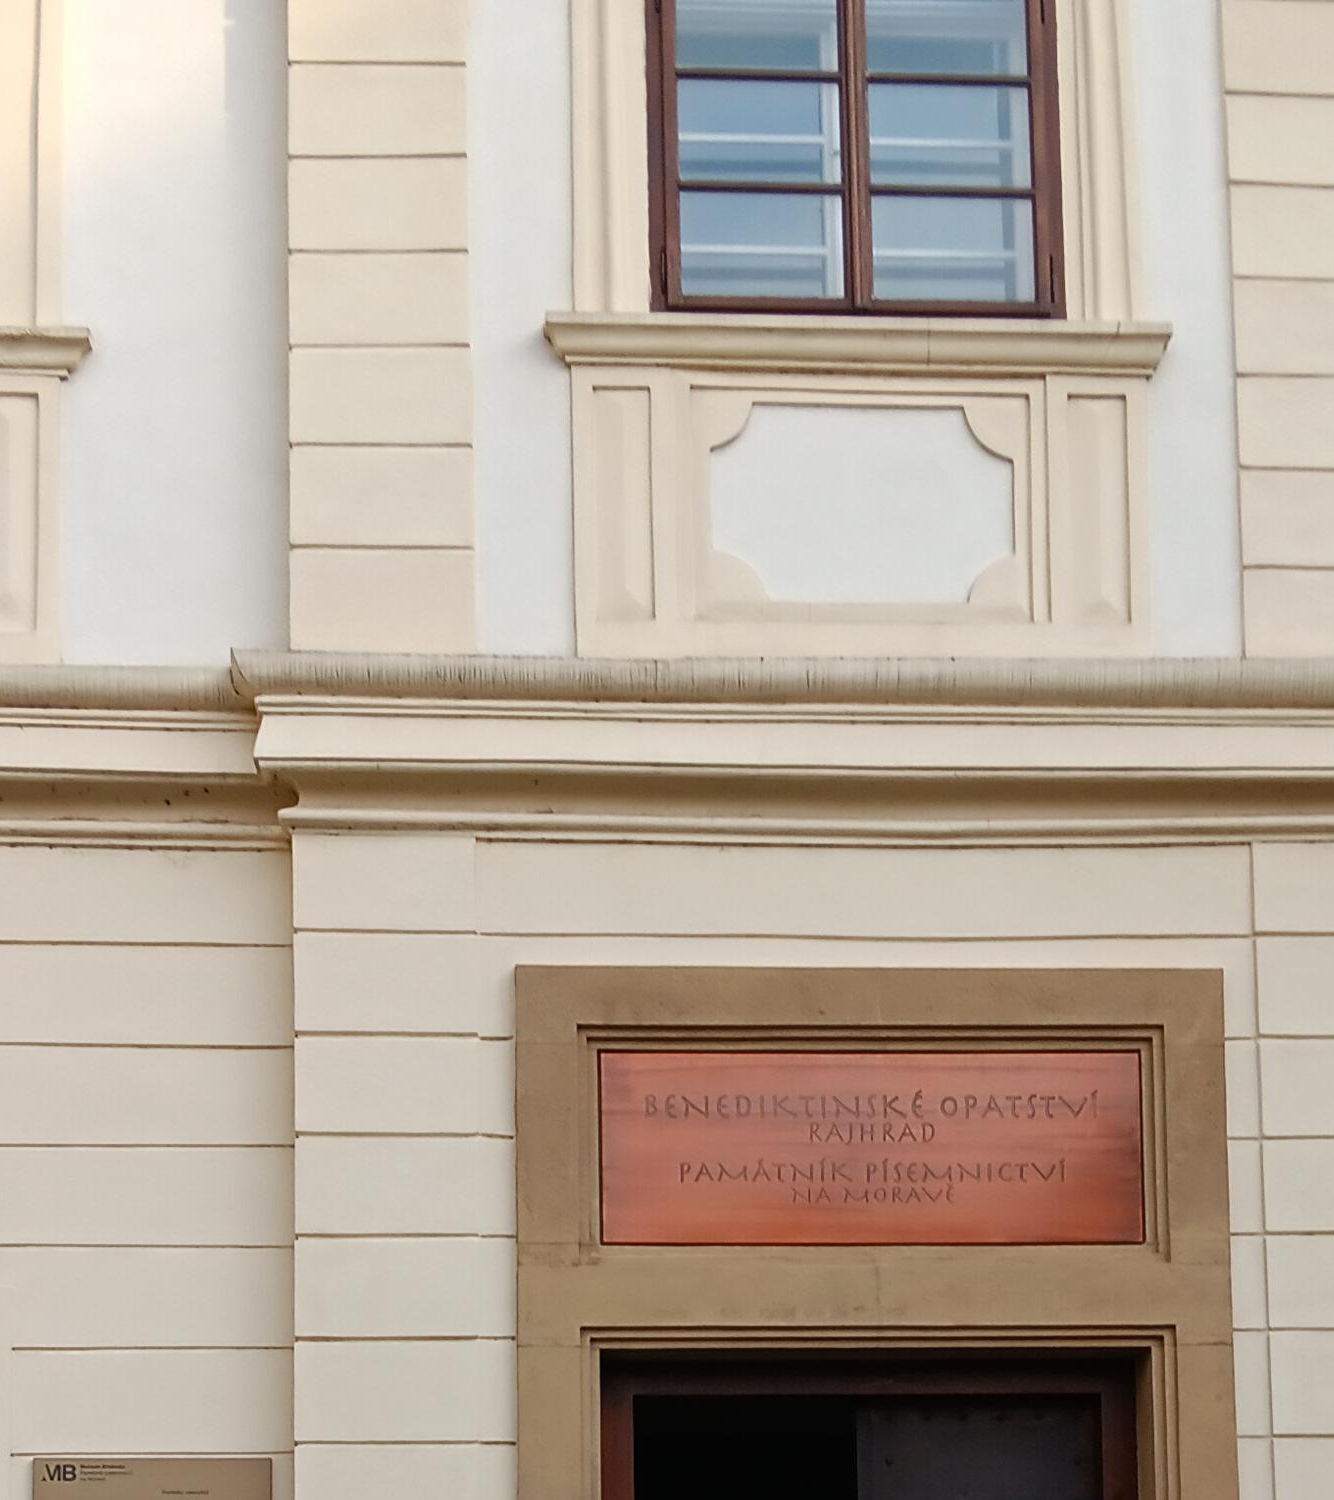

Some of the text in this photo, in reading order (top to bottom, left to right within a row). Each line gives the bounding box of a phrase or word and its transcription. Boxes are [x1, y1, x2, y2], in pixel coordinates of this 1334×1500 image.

[644, 1089, 1099, 1120] BENEDIKTINSKÉ OPATSTVÍ
[809, 1122, 936, 1145] RAJHRAD
[679, 1158, 1066, 1183] PAMÁTNÍK PÍSEMNICTVÍ
[792, 1184, 955, 1204] NA MORAVĚ
